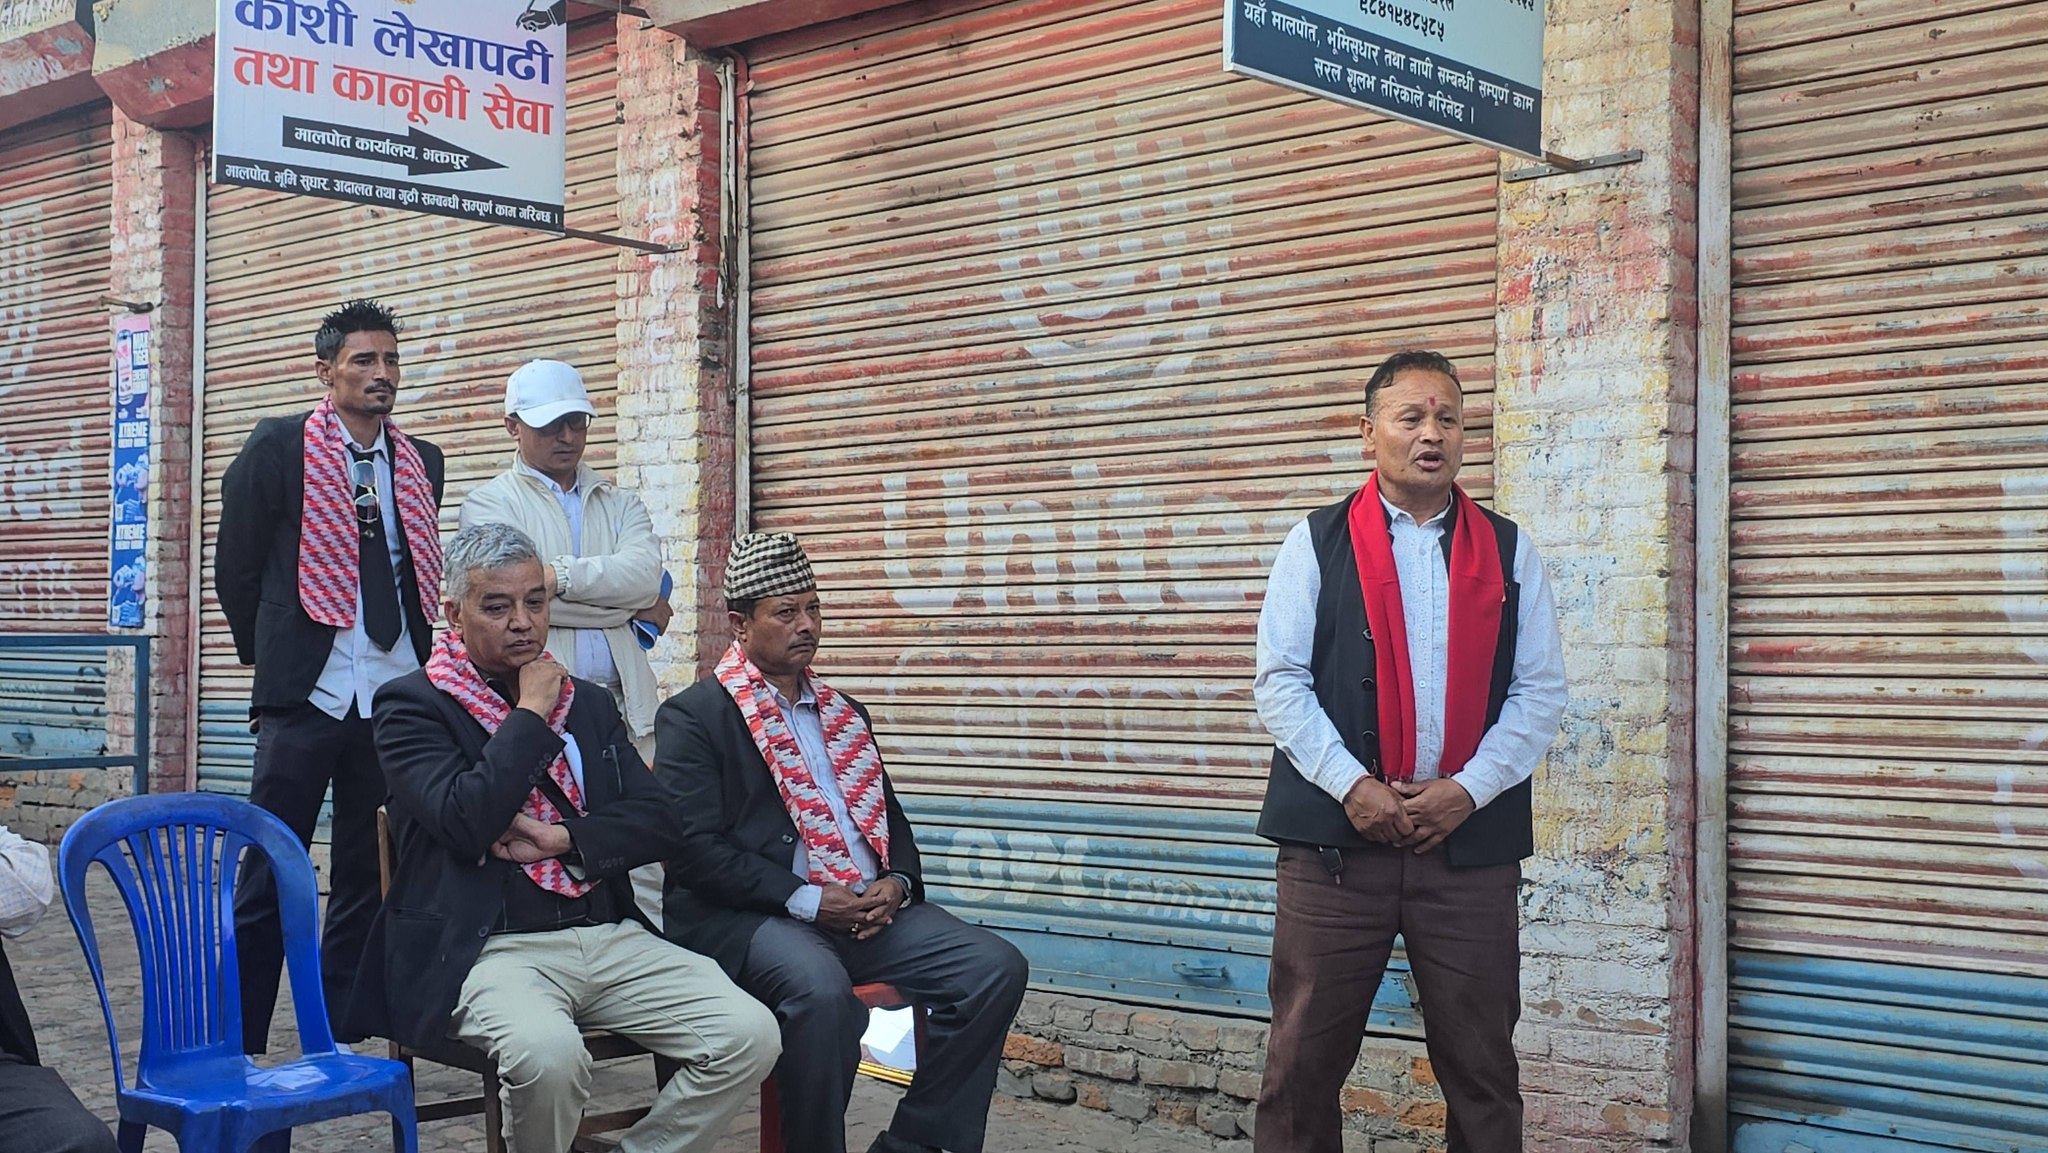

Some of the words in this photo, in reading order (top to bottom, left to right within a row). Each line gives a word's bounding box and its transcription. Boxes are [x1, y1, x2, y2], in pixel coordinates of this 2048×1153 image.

[373, 10, 554, 85] लेखापढी
[1243, 0, 1267, 28] यहाँ
[1271, 11, 1320, 47] मालपोत,
[1327, 26, 1380, 66] भूमिसुधार
[1384, 49, 1405, 70] तथा
[1409, 57, 1433, 80] नापी
[1438, 66, 1475, 92] सम्बन्धी
[1478, 80, 1510, 106] सम्पूर्ण
[1513, 91, 1534, 112] काम
[234, 47, 319, 94] तथा
[333, 64, 470, 125] कानूनी
[483, 83, 554, 135] सेवा
[1314, 57, 1342, 82] सरल
[1346, 67, 1376, 93] शुलभ
[1380, 75, 1424, 108] तरिकाले
[1428, 92, 1464, 122] गरिनेछ
[294, 127, 351, 149] मालपोत
[423, 147, 470, 170] भक्तपुर
[275, 168, 297, 188] भूमि
[333, 179, 372, 197] अदालत
[375, 185, 395, 200] तथा
[399, 187, 418, 206] गुठी
[421, 192, 459, 210] सम्बन्धी
[462, 199, 492, 217] सम्पूर्ण
[495, 203, 516, 218] काम
